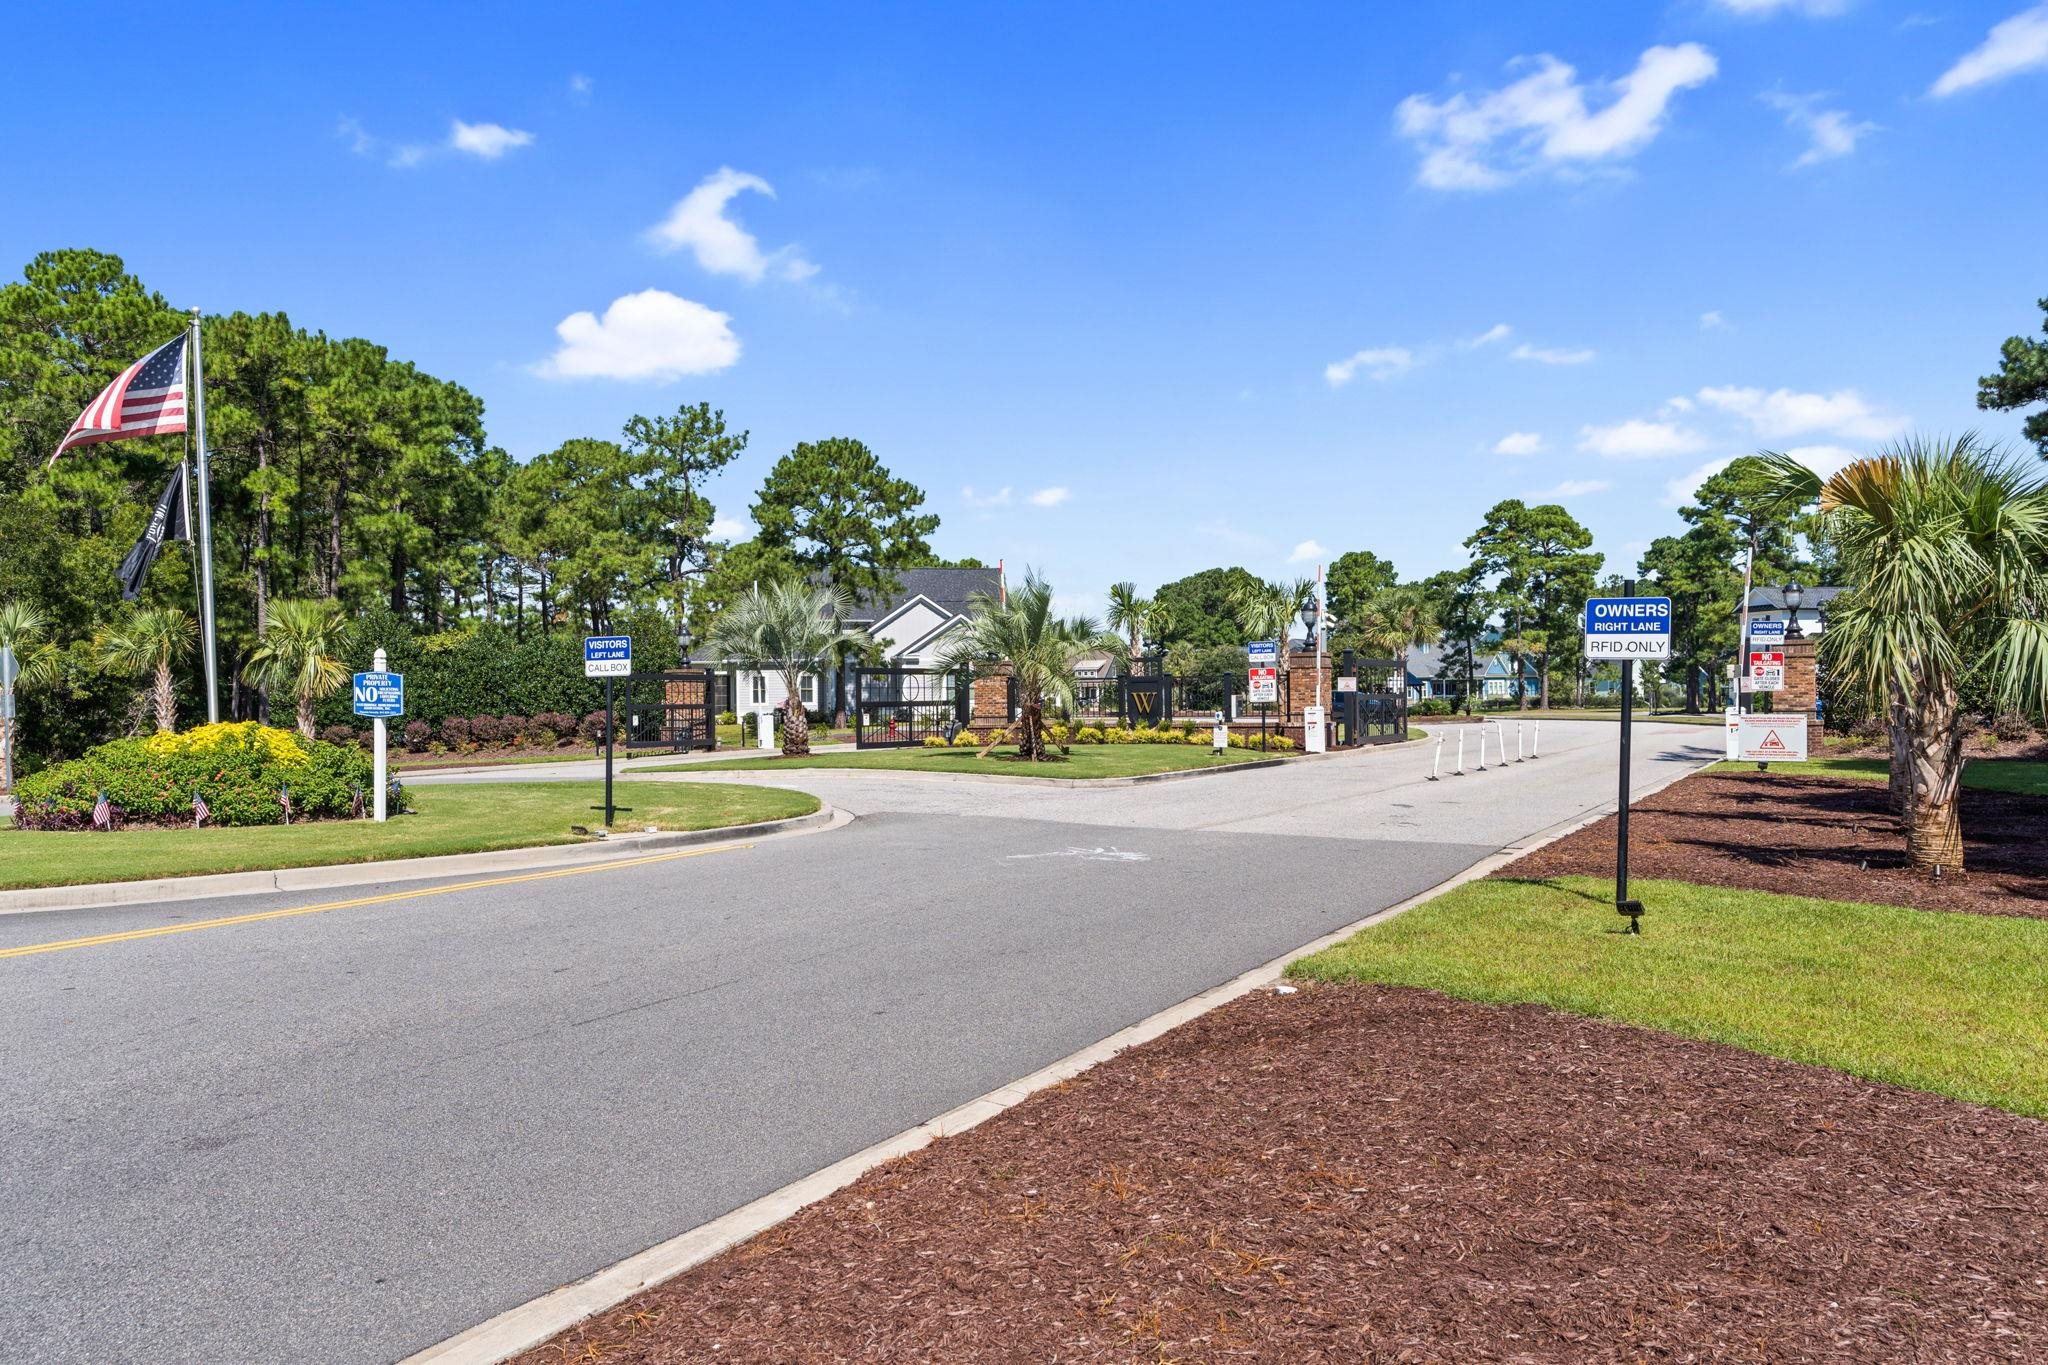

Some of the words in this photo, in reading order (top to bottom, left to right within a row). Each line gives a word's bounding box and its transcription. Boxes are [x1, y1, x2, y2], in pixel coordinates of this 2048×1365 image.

[1595, 604, 1668, 617] OWNERS
[1594, 622, 1628, 631] RIGHT
[1631, 622, 1661, 631] LANE
[589, 640, 627, 649] VISITORS
[1591, 641, 1623, 652] RFID
[1627, 641, 1665, 652] ONLY
[1762, 653, 1773, 661] NO
[588, 664, 609, 672] CALL
[611, 663, 628, 672] BOX
[355, 687, 378, 702] NO
[1131, 692, 1158, 714] W
